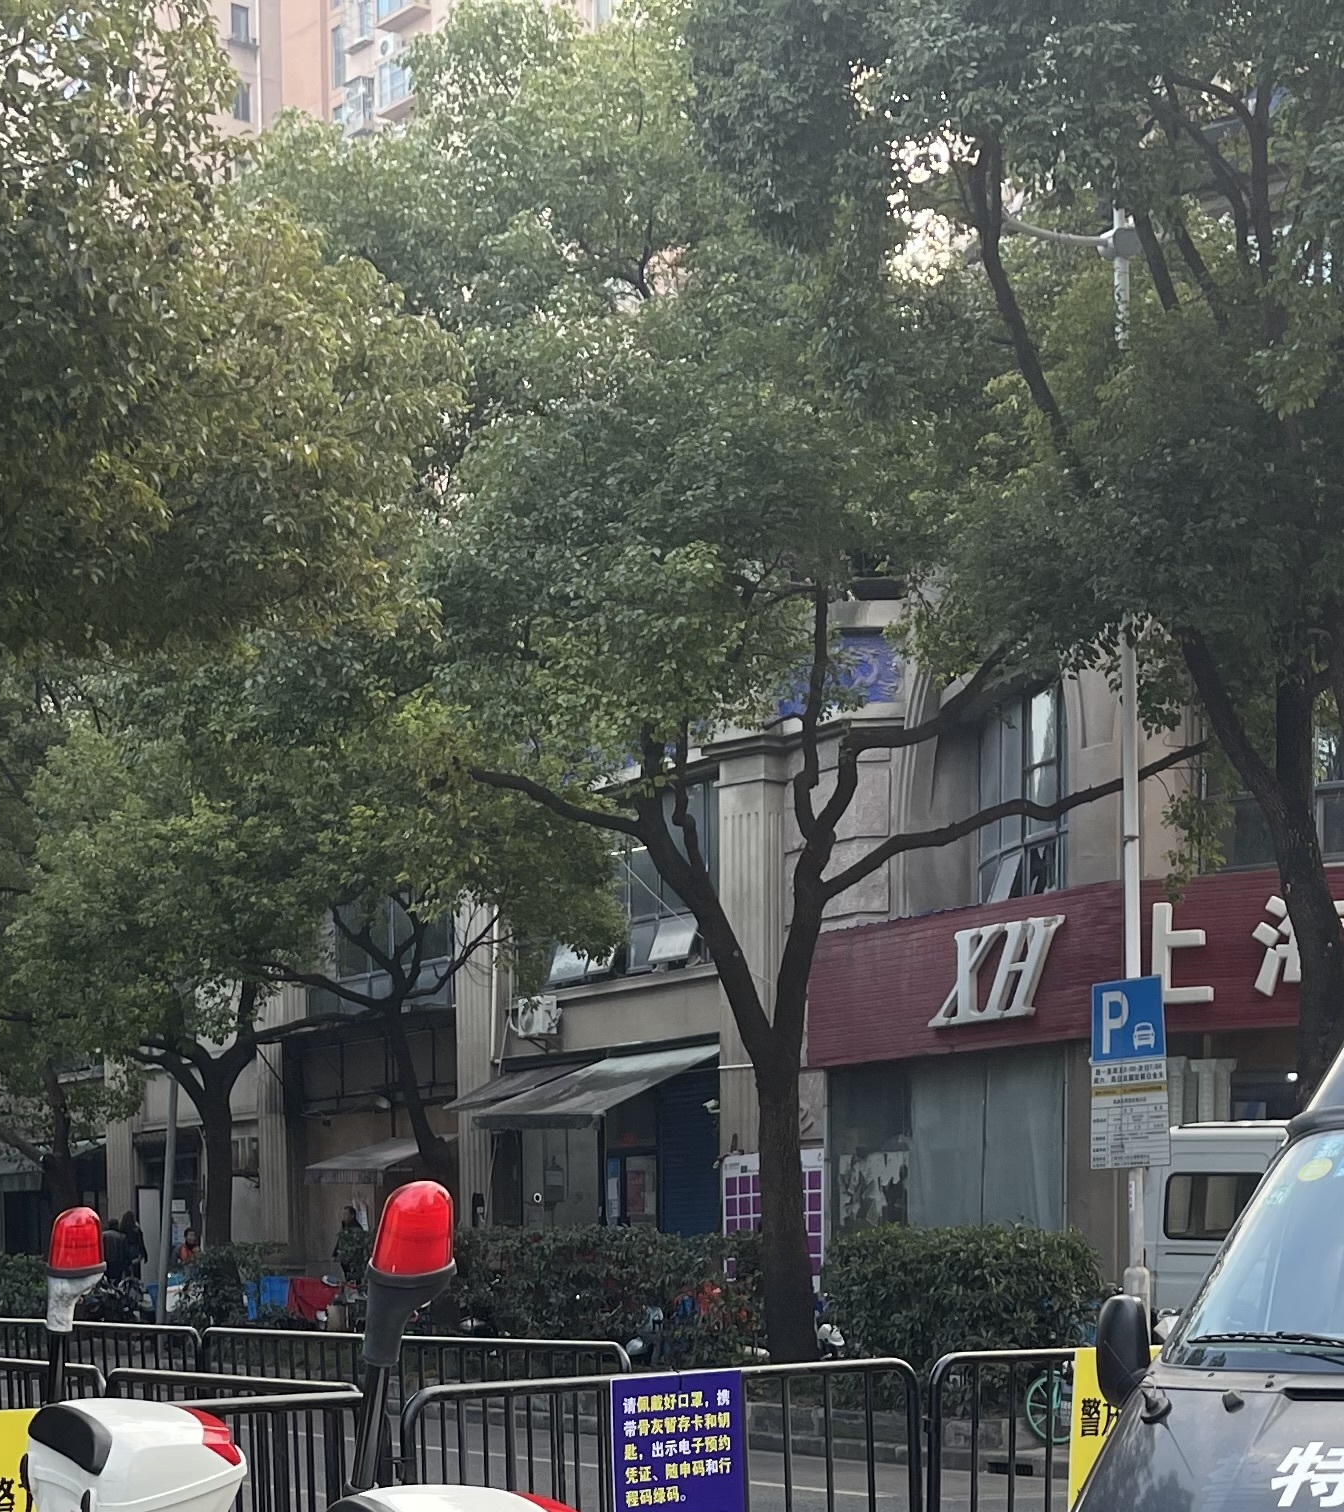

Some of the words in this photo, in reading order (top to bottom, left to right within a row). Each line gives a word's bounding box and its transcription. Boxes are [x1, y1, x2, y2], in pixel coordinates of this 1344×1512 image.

[928, 914, 1067, 1028] XH
[1101, 991, 1130, 1054] P
[623, 1412, 730, 1437] 带骨灰暂存卡和钥
[624, 1435, 731, 1460] 匙，出示电子预约
[625, 1457, 731, 1484] 凭证、随申码和行
